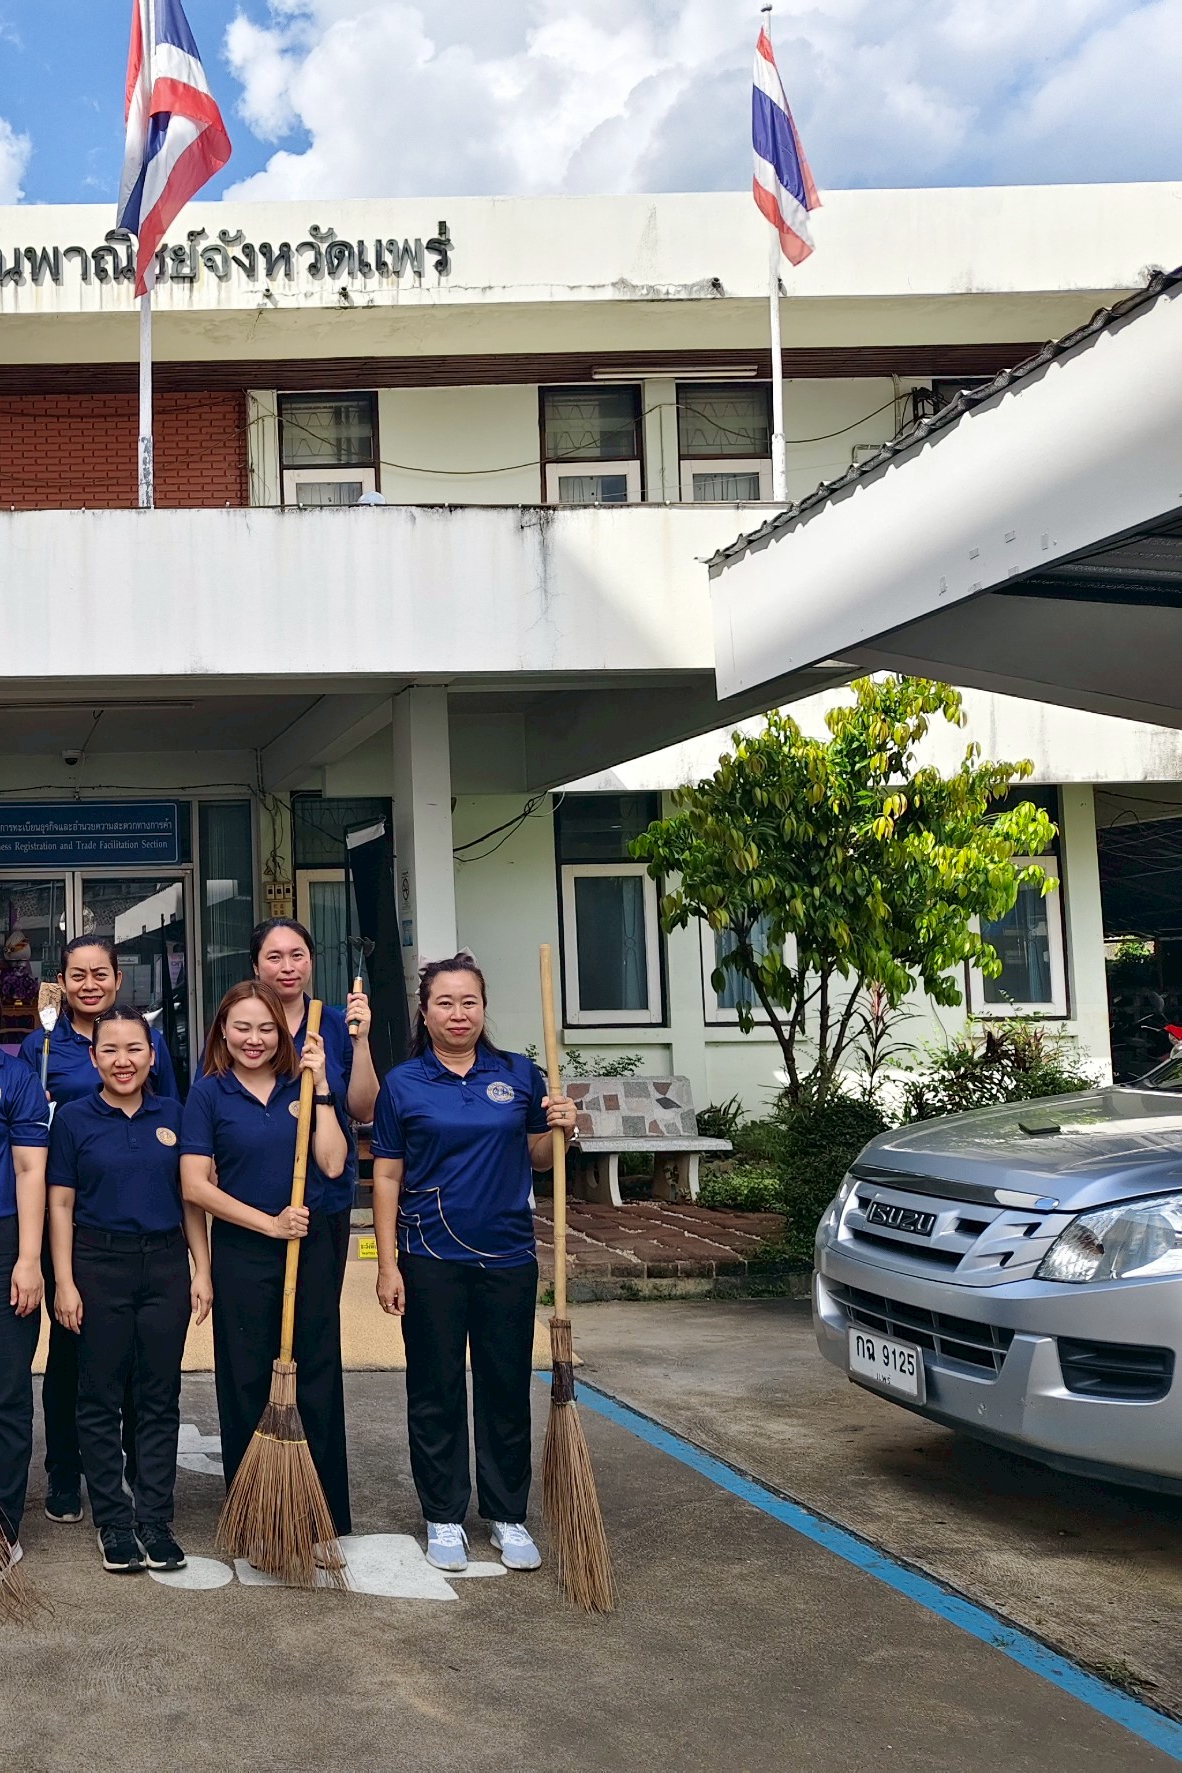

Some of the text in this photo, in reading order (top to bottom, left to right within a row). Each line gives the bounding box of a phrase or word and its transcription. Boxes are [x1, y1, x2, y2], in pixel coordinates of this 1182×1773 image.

[15, 840, 57, 852] Registration
[60, 840, 73, 850] and
[76, 840, 97, 850] Trade
[99, 839, 139, 850] Facilitation
[141, 839, 168, 849] Section
[870, 1204, 934, 1233] ISUZU
[856, 1335, 915, 1376] กฉ 9125
